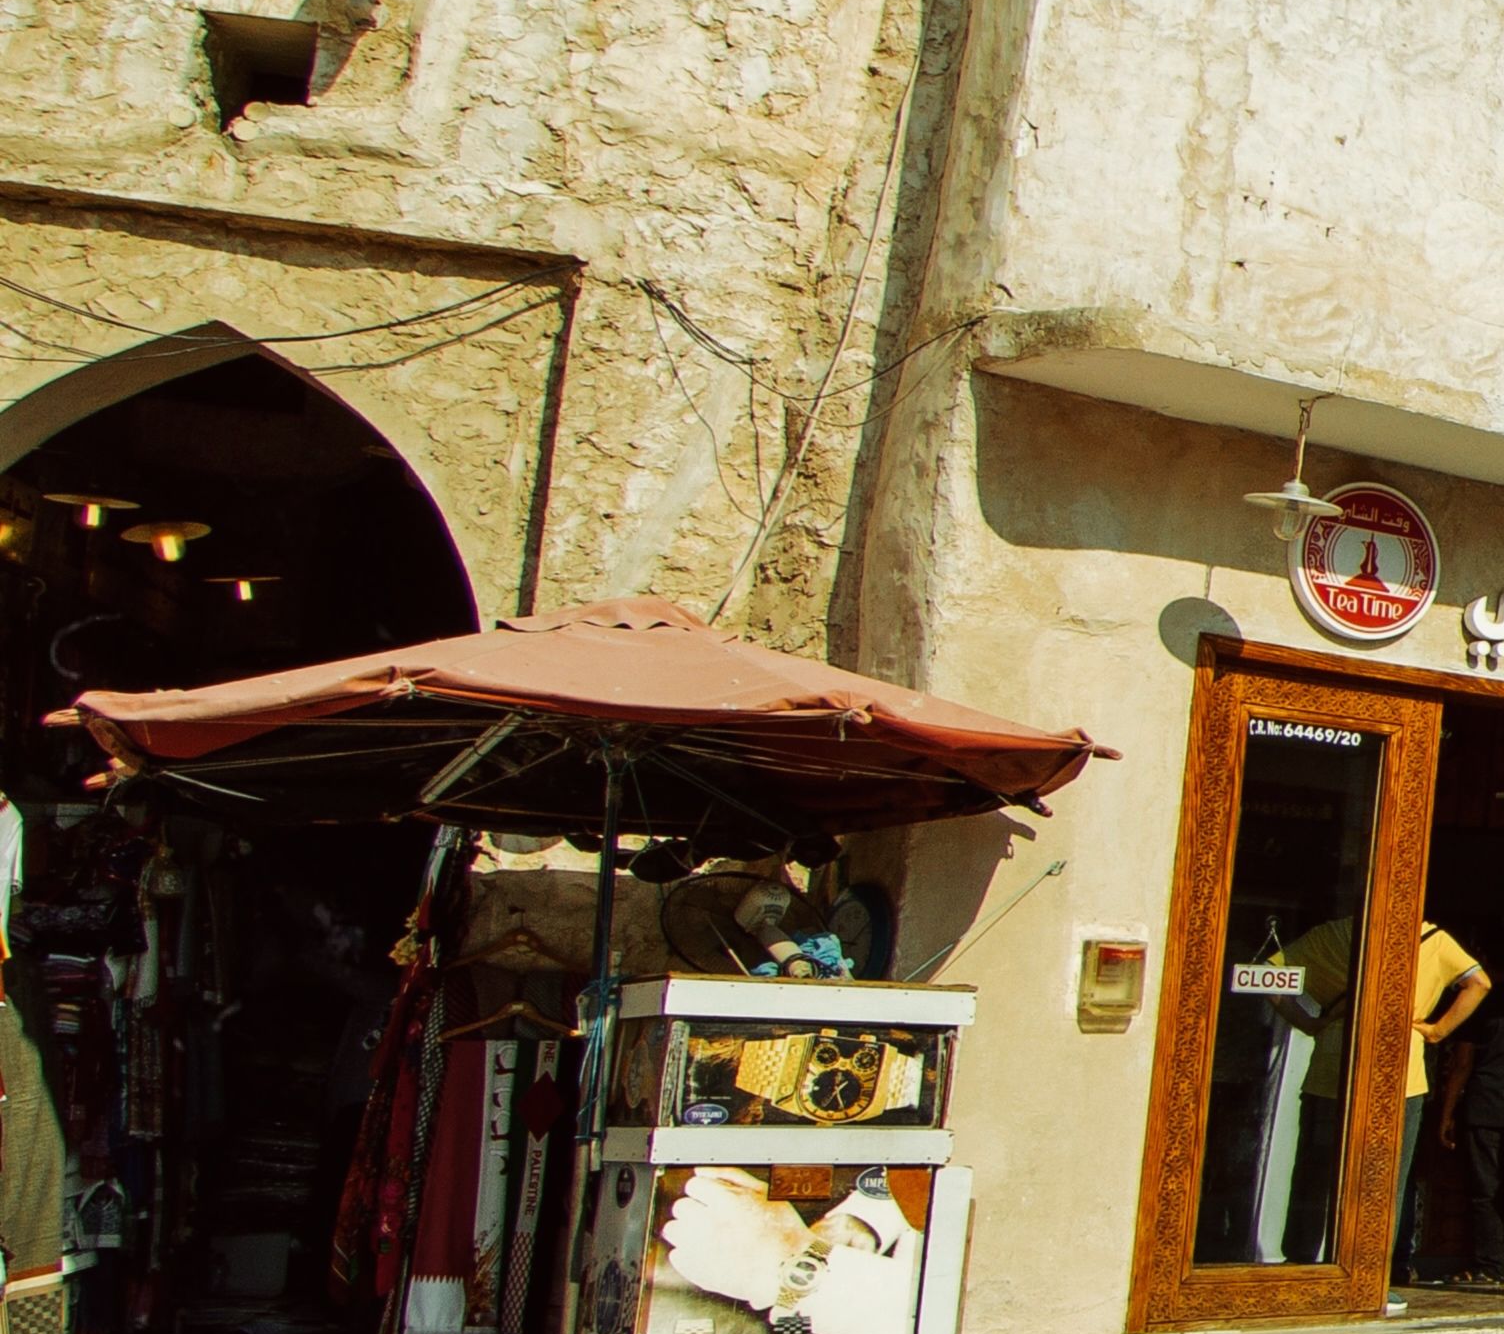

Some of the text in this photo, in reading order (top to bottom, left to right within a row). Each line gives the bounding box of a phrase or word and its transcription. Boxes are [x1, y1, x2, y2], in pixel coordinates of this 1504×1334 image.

[1327, 587, 1403, 620] Tea Time
[1237, 970, 1299, 989] CLOSE
[525, 1150, 542, 1217] PALESTINE
[864, 1177, 888, 1188] IMPE
